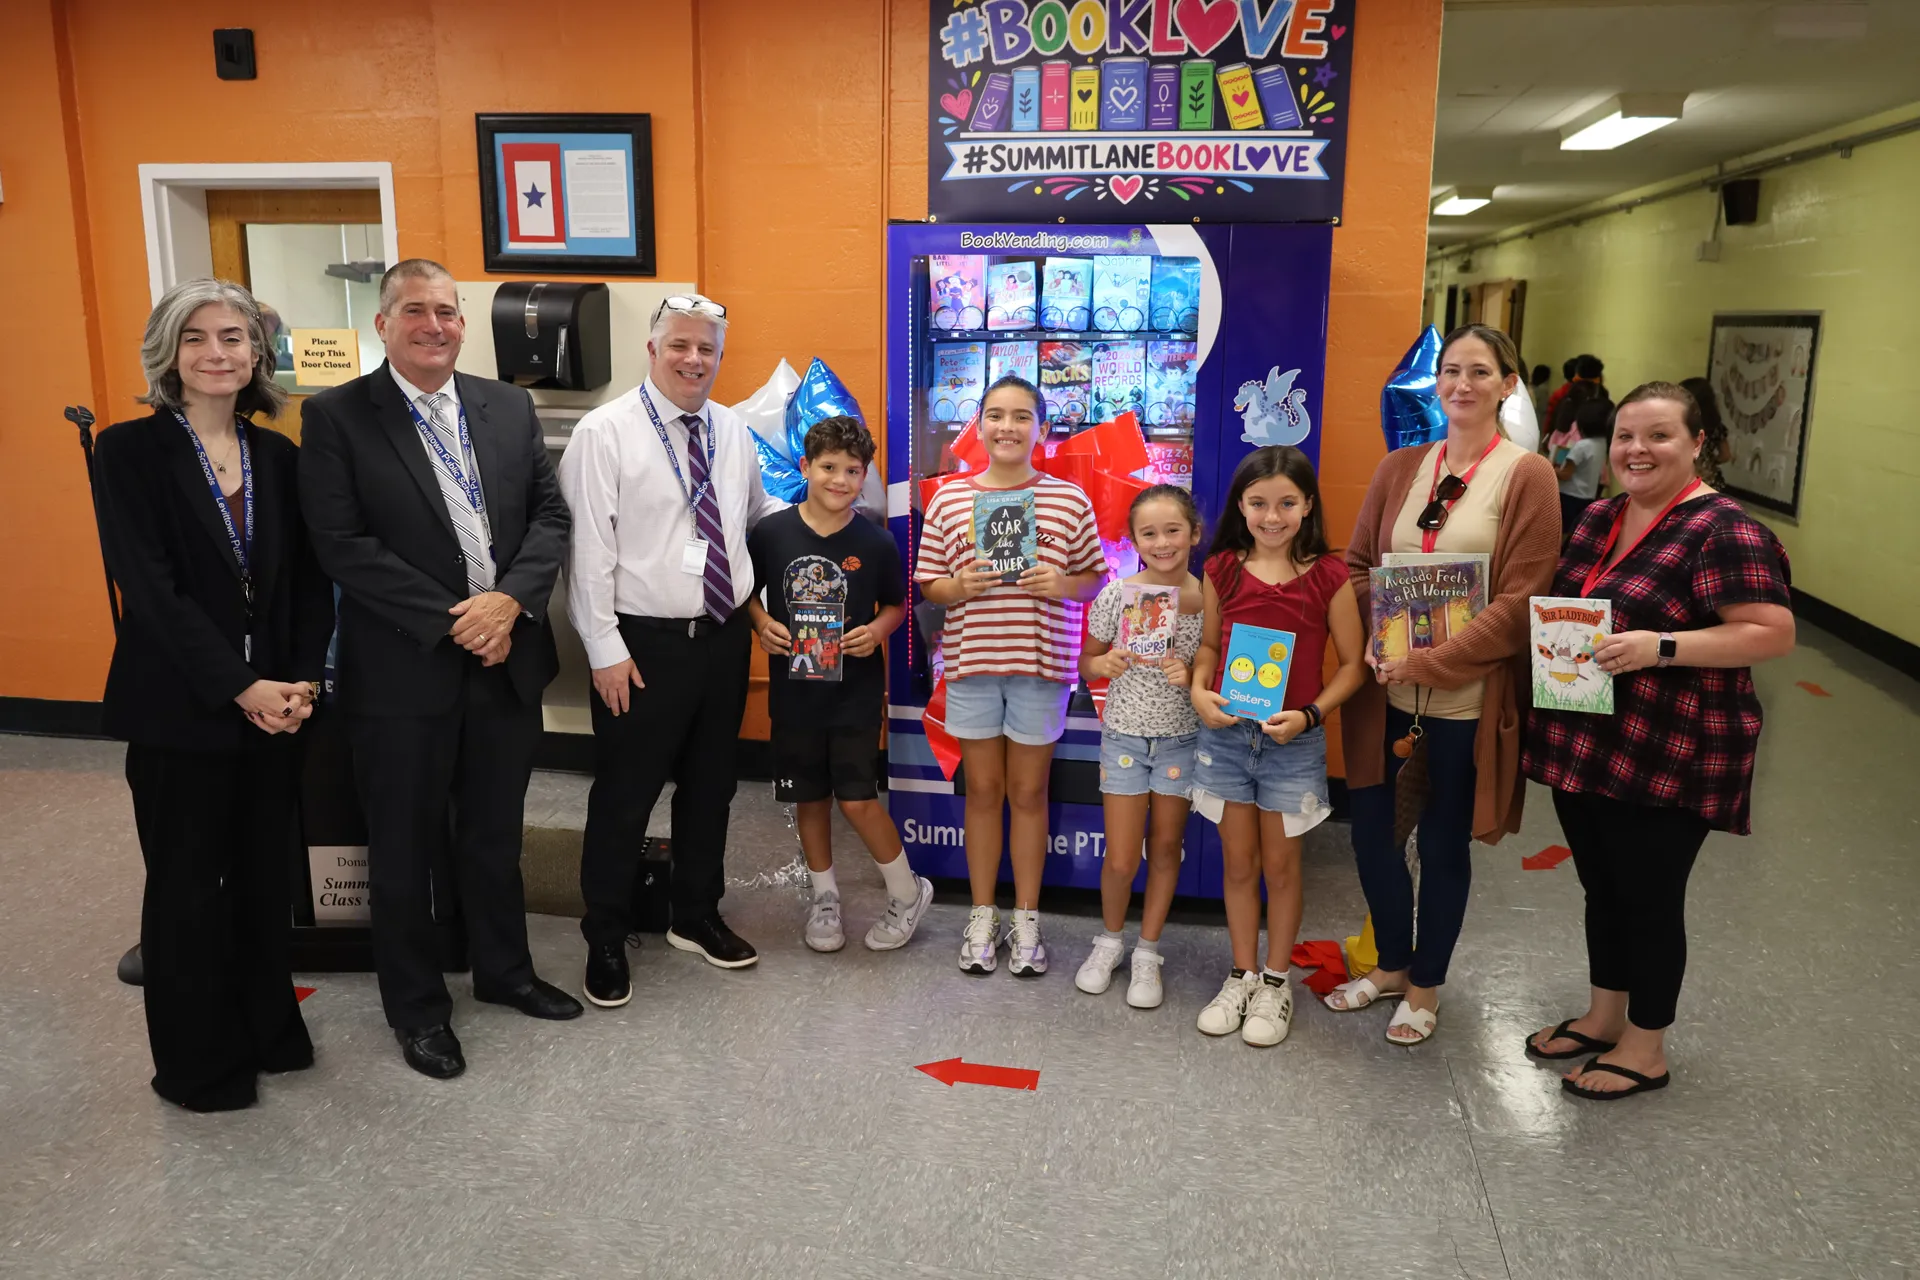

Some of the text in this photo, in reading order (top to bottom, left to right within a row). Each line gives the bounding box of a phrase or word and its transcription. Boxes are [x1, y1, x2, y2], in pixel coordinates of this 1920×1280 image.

[961, 232, 1109, 251] BookVending.com
[304, 349, 346, 358] Keep This
[991, 344, 1019, 357] TAYLOR
[940, 357, 959, 367] Pete
[1010, 355, 1034, 368] SWIFT
[1098, 361, 1142, 375] WORLD
[1041, 364, 1089, 385] ROCKS
[1094, 374, 1142, 387] RECORDS
[460, 415, 470, 445] Schools
[416, 419, 444, 455] Levittown
[441, 452, 460, 477] Public
[653, 418, 666, 441] Public
[664, 440, 679, 468] Schools
[197, 451, 216, 486] Schools
[241, 439, 254, 541] Levittown Public Schools
[1002, 508, 1010, 519] A
[215, 497, 246, 566] Levittown Public
[990, 519, 1022, 536] SCAR
[997, 537, 1014, 548] like
[992, 556, 1024, 572] RIVER
[1385, 569, 1468, 589] Avocado Feels
[1394, 583, 1468, 603] a Pit Worried
[794, 613, 837, 622] ROBLOX
[1160, 615, 1167, 627] 2
[1558, 609, 1599, 624] LADYBUG
[1128, 639, 1166, 654] TAYLORS
[1229, 688, 1272, 708] Sisters
[1074, 831, 1107, 858] PT
[319, 892, 362, 907] Class
